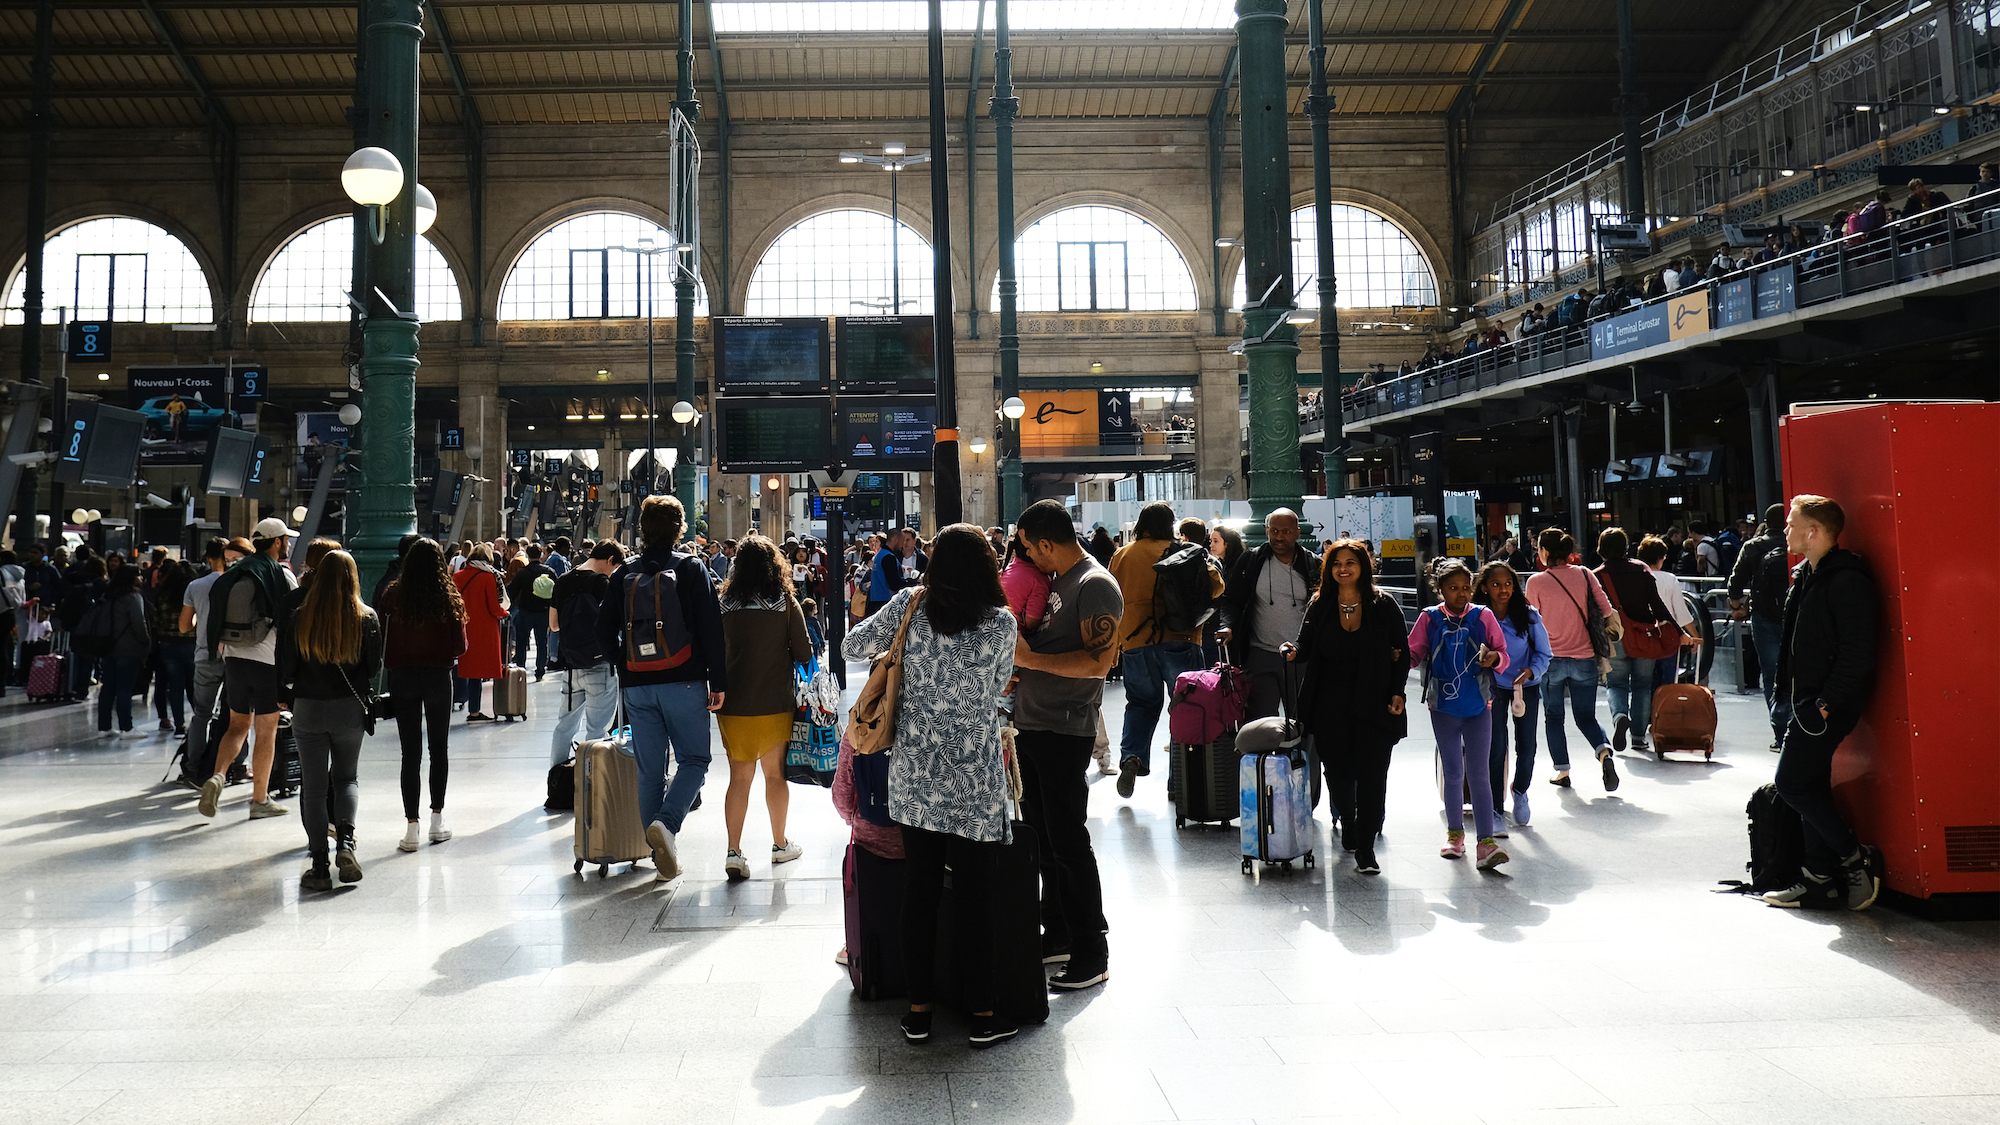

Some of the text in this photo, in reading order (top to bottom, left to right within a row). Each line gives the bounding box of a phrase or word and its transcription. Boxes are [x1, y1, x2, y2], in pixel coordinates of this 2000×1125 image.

[1616, 317, 1660, 337] Terminal Eurostar
[84, 333, 97, 353] 8
[134, 378, 212, 387] Nouveau T-Cross.
[246, 379, 256, 394] 9
[70, 432, 81, 457] 8
[446, 434, 459, 445] 11
[517, 454, 528, 463] 12
[549, 464, 560, 472] 13
[1466, 490, 1481, 500] TEA
